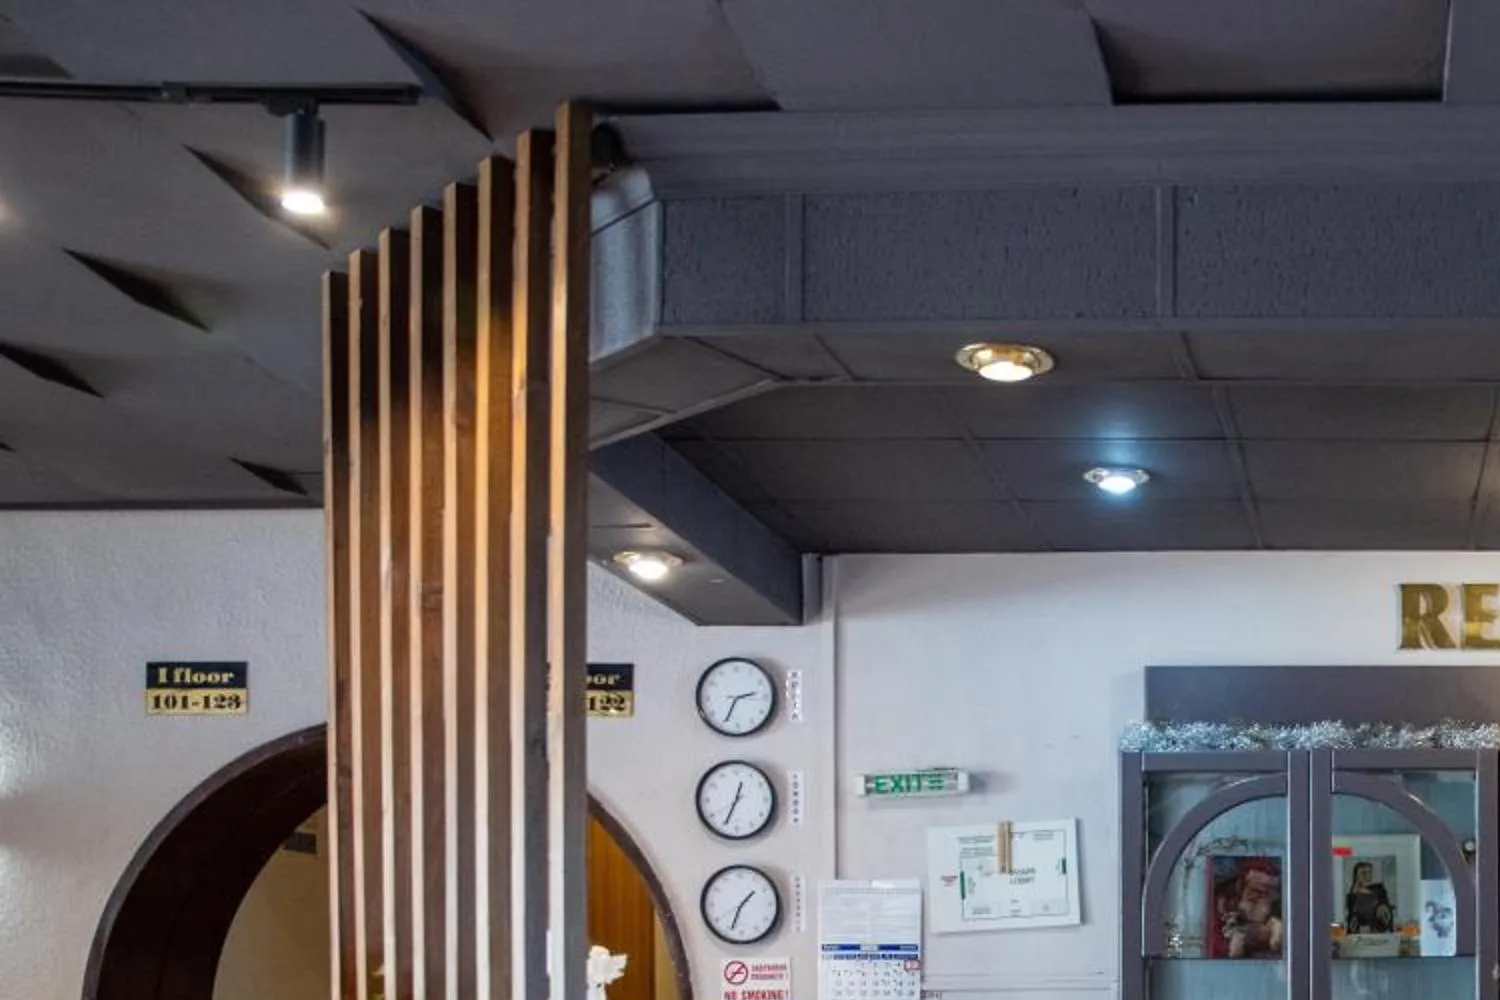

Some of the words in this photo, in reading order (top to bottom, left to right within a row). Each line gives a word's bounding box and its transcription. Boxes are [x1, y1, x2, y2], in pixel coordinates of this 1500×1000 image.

[174, 667, 235, 684] floor
[152, 694, 241, 709] 101-123
[588, 695, 625, 711] 122
[874, 774, 926, 794] EXIT
